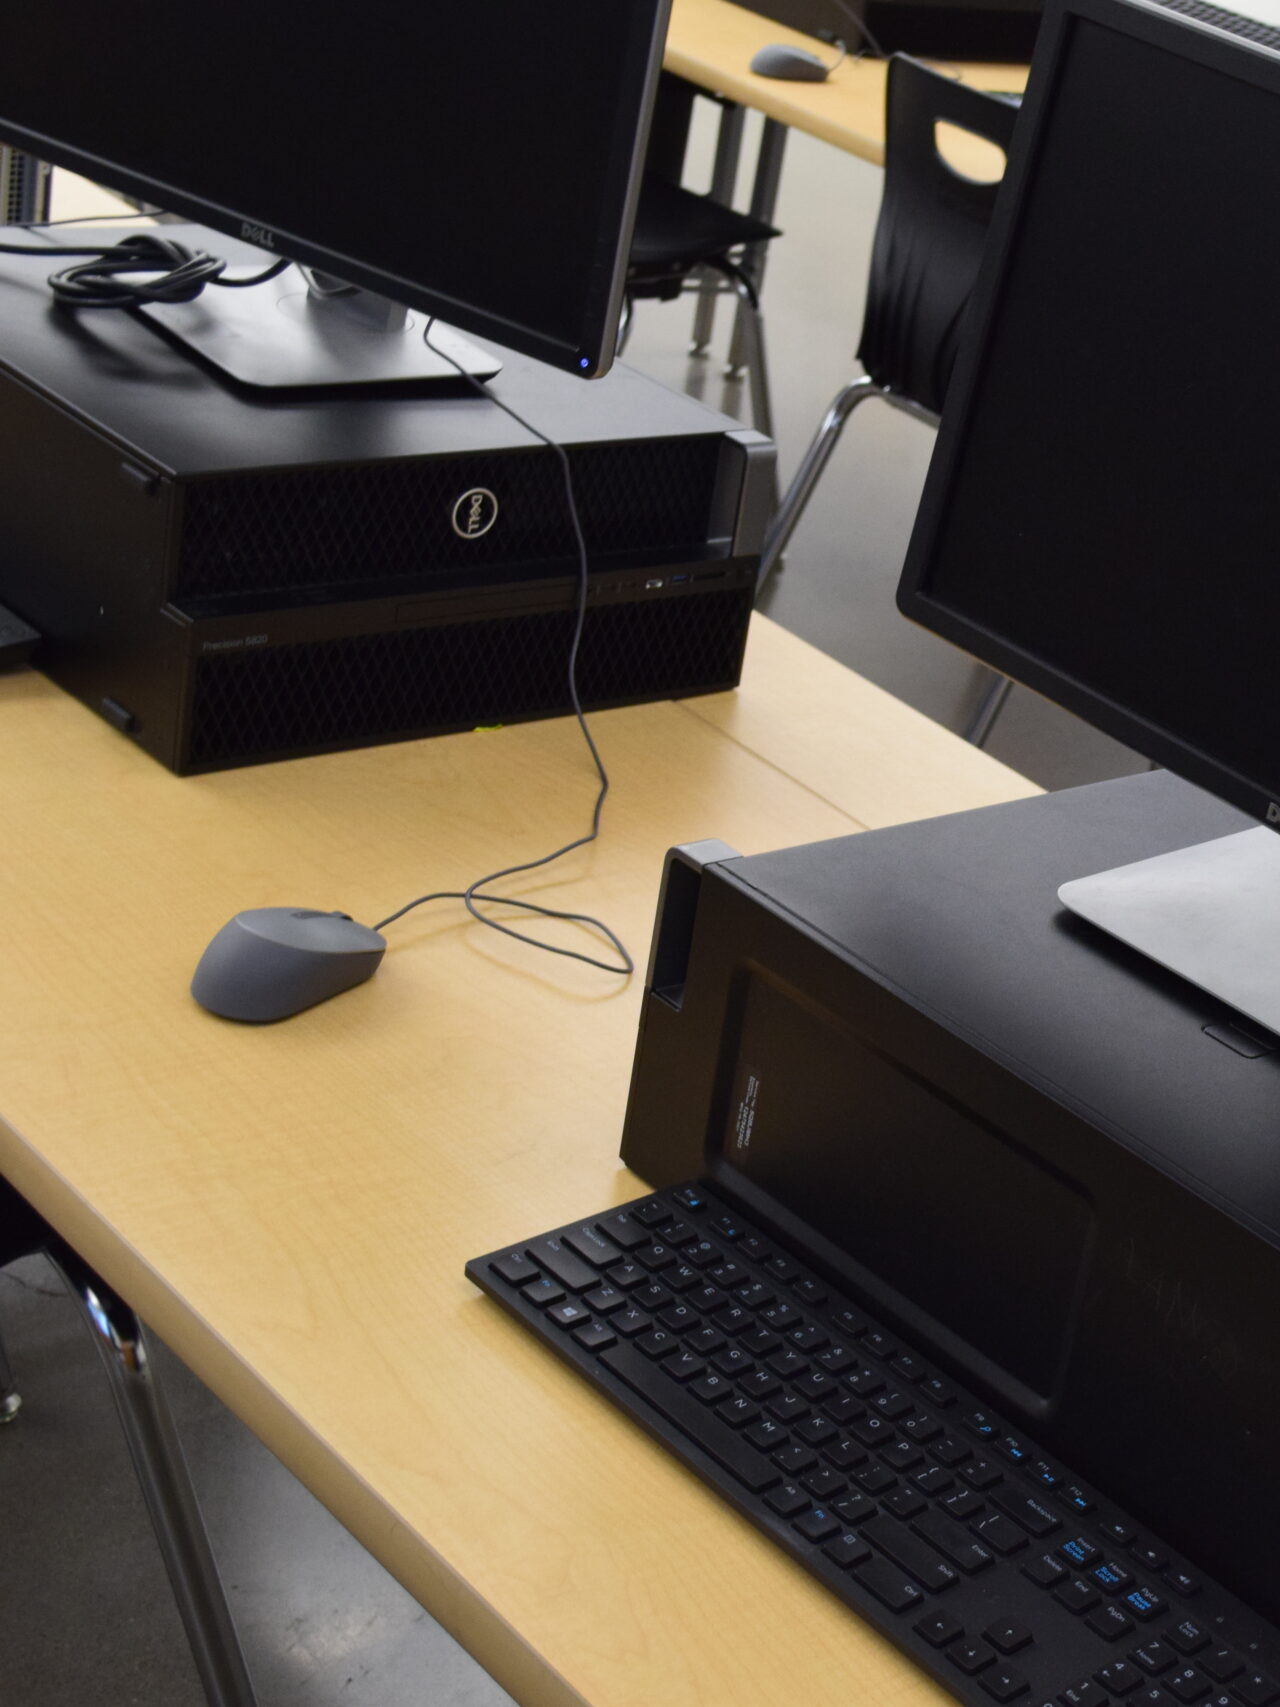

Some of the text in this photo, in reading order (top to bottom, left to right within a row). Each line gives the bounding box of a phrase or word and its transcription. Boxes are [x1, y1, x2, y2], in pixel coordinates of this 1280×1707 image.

[240, 221, 275, 249] DELL
[467, 494, 484, 534] DELL
[654, 1246, 664, 1255] Q
[624, 1264, 634, 1273] A
[680, 1266, 692, 1277] W
[601, 1287, 614, 1296] Z
[650, 1285, 661, 1294] S
[704, 1287, 715, 1296] E
[626, 1309, 639, 1318] X
[675, 1306, 686, 1315] D
[730, 1308, 741, 1317] R
[654, 1332, 665, 1341] C
[702, 1328, 714, 1336] F
[758, 1329, 769, 1337] T
[682, 1353, 693, 1362] V
[730, 1350, 741, 1359] G
[786, 1352, 797, 1360] Y
[707, 1376, 719, 1385] B
[755, 1371, 768, 1382] H
[812, 1373, 825, 1382] U
[734, 1399, 747, 1409] N
[785, 1396, 796, 1404] J
[812, 1417, 825, 1426] K
[762, 1421, 776, 1432] M
[841, 1441, 850, 1450] L
[898, 1442, 909, 1450] P
[904, 1585, 918, 1597] Ctrl
[1075, 1580, 1089, 1593] End
[1107, 1606, 1125, 1622] PgDn
[1136, 1648, 1155, 1665] Home
[1184, 1669, 1194, 1678] 8
[1066, 1689, 1080, 1702] End
